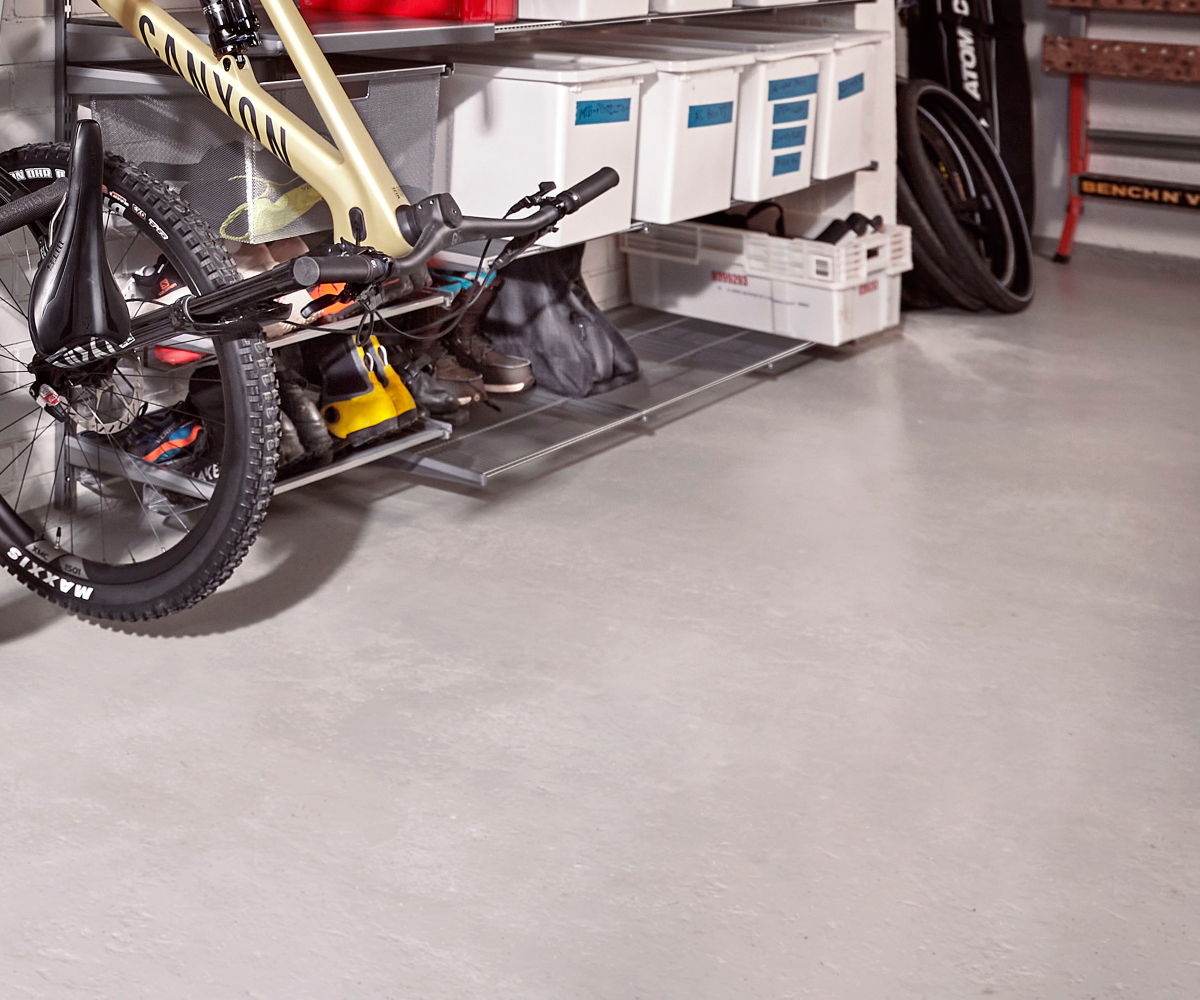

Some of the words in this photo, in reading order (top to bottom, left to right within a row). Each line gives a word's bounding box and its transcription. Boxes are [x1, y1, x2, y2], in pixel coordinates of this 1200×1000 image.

[139, 15, 293, 170] CANYON
[25, 167, 53, 180] DHR
[1081, 180, 1160, 201] BENCH
[31, 544, 50, 560] XMC
[6, 546, 94, 601] MAXXIS
